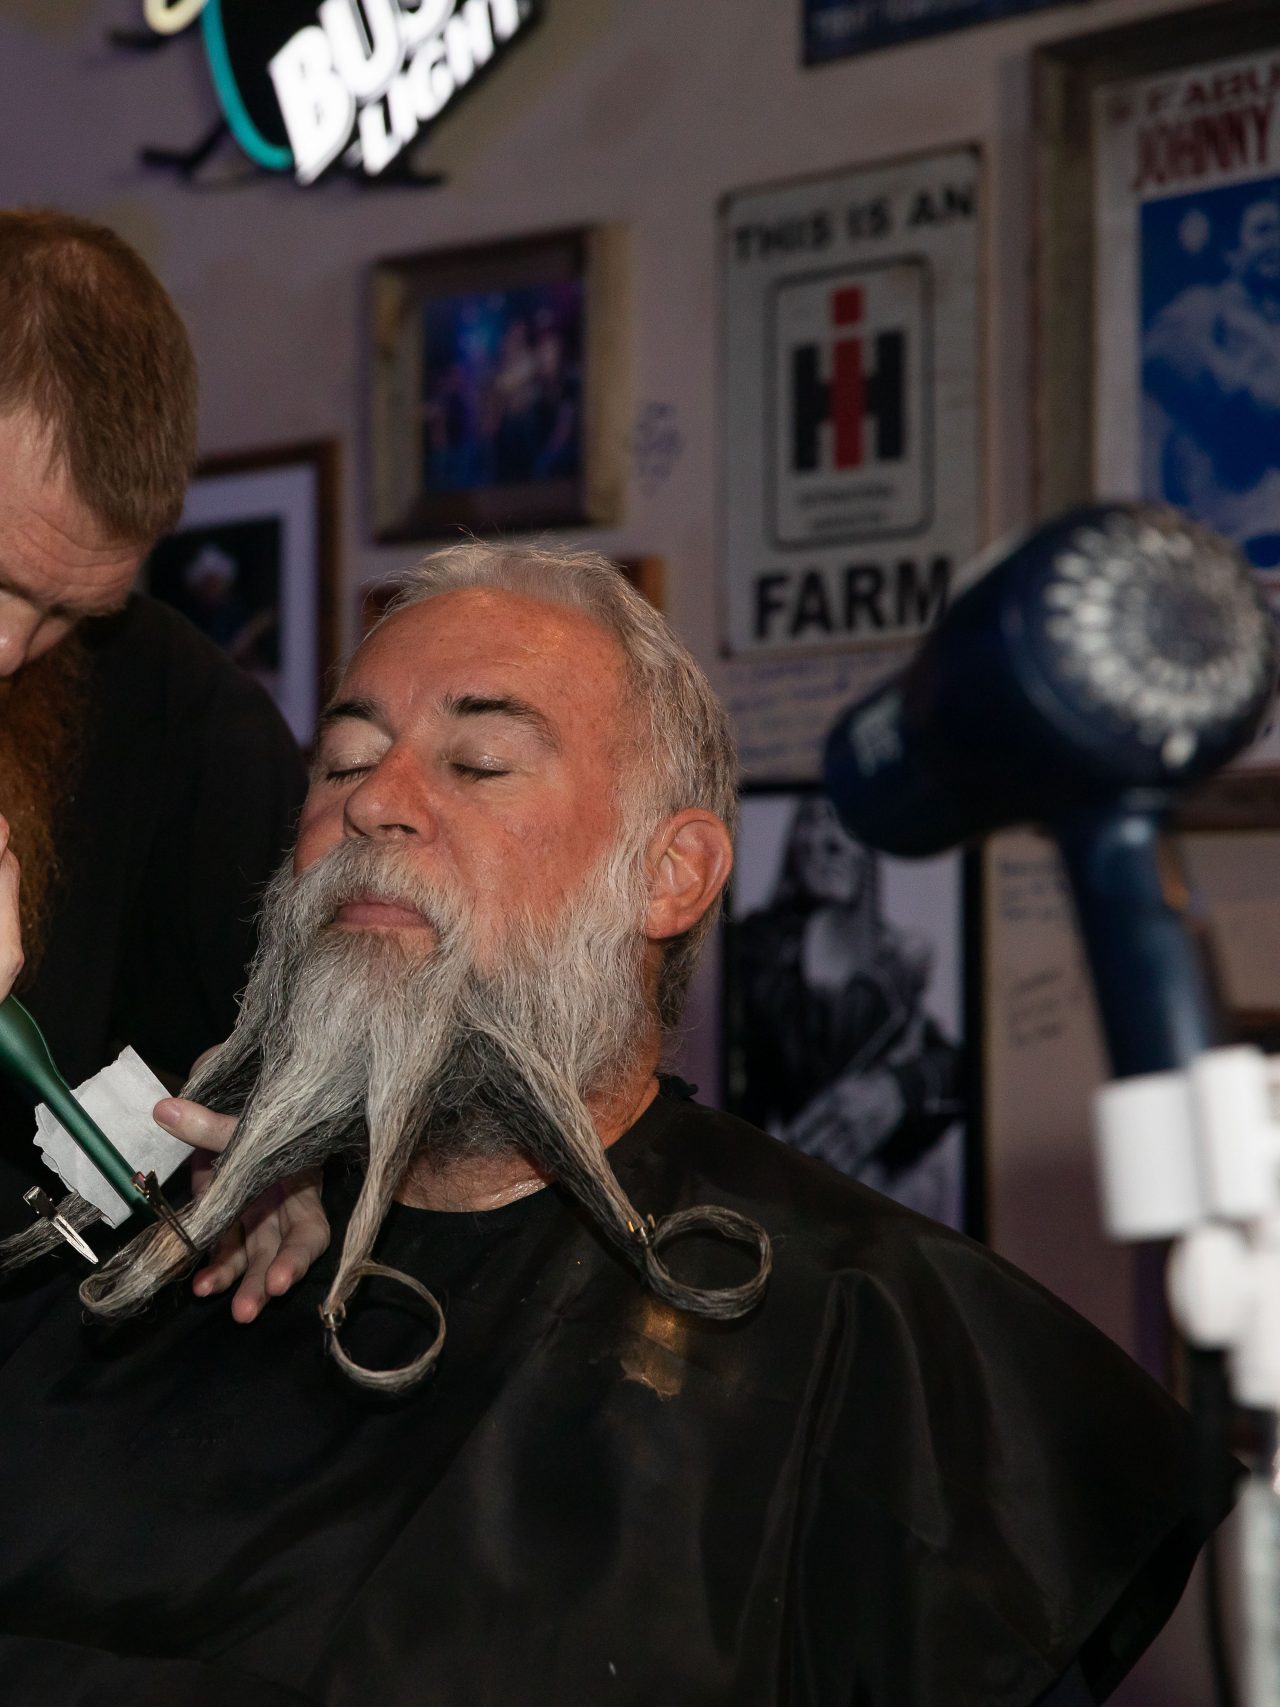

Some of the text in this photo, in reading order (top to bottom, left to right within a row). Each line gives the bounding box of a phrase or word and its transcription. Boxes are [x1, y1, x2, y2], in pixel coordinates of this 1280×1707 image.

[1130, 103, 1272, 191] JOHNNY
[734, 185, 975, 261] THIS IS AN
[754, 556, 952, 638] FARM
